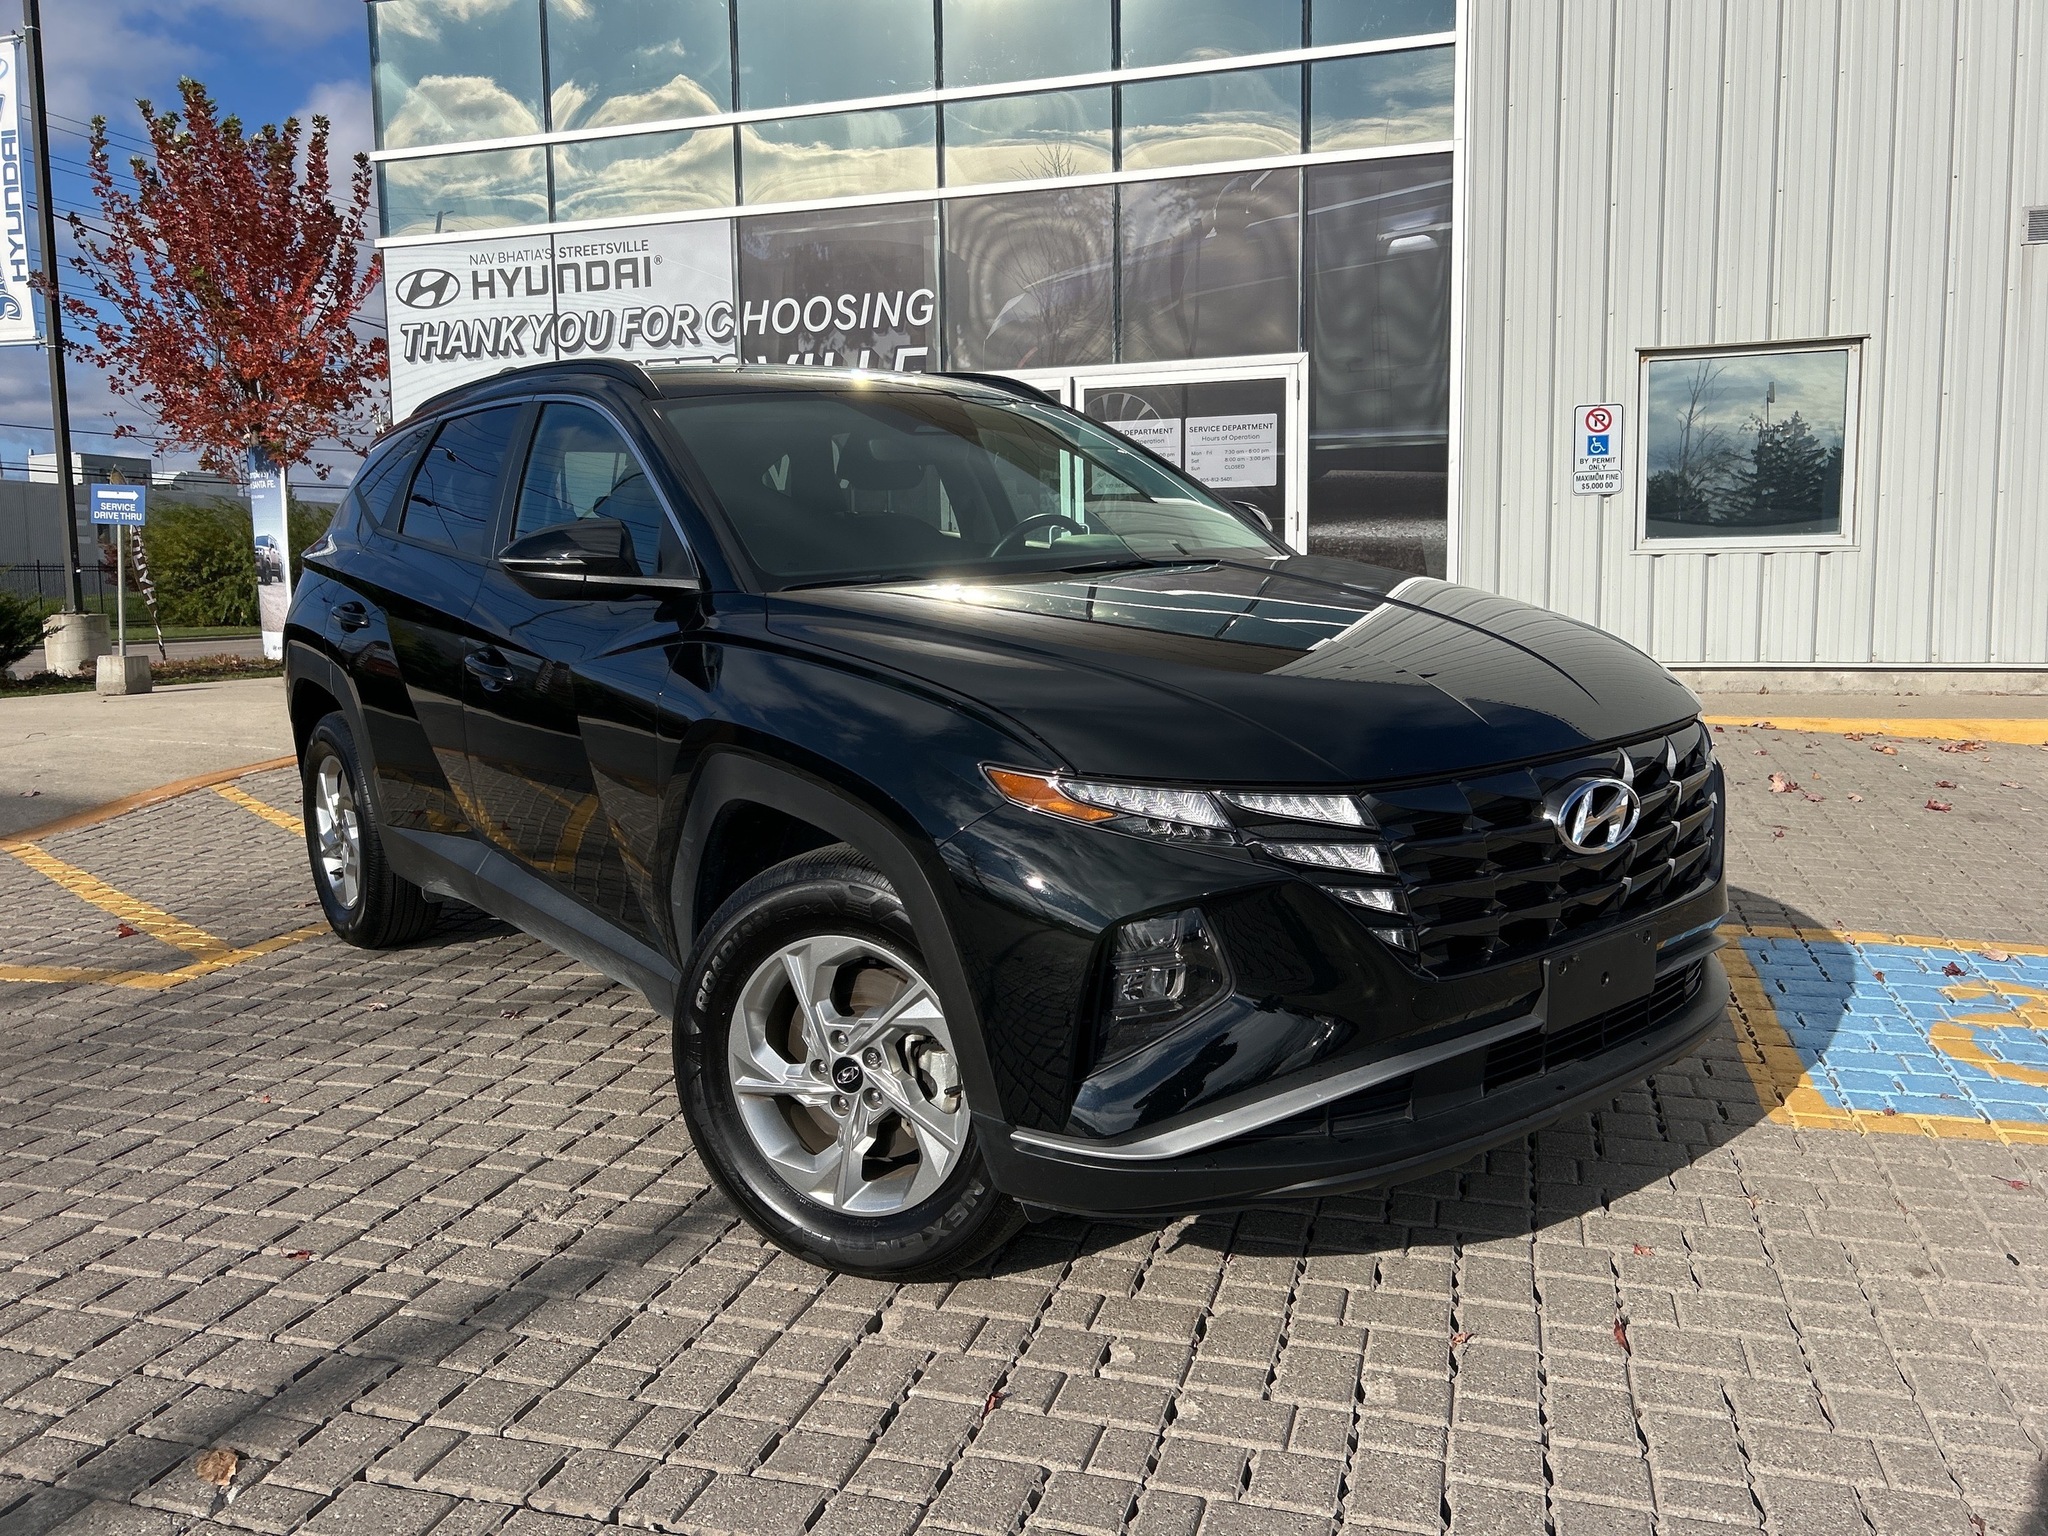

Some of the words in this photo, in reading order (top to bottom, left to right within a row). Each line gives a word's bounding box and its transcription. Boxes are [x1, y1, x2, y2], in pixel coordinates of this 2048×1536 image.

[1, 129, 28, 283] HYUNDAI
[469, 253, 495, 266] NAV
[499, 248, 552, 263] BHATIA'S
[559, 240, 649, 259] STREETSVILLE
[400, 315, 526, 364] THANK
[529, 310, 615, 358] YOU
[619, 303, 702, 350] FOR
[704, 288, 935, 345] CHOOSING
[1124, 427, 1174, 436] DEPARTMENT
[1189, 425, 1220, 433] SERVICE
[1222, 422, 1274, 432] DEPARTMENT
[1228, 433, 1260, 442] Operation
[1575, 473, 1605, 482] MAXIMUM
[1605, 473, 1620, 481] FINE
[100, 502, 136, 512] SERVICE
[94, 511, 120, 520] DRIVE
[119, 512, 143, 521] THRU
